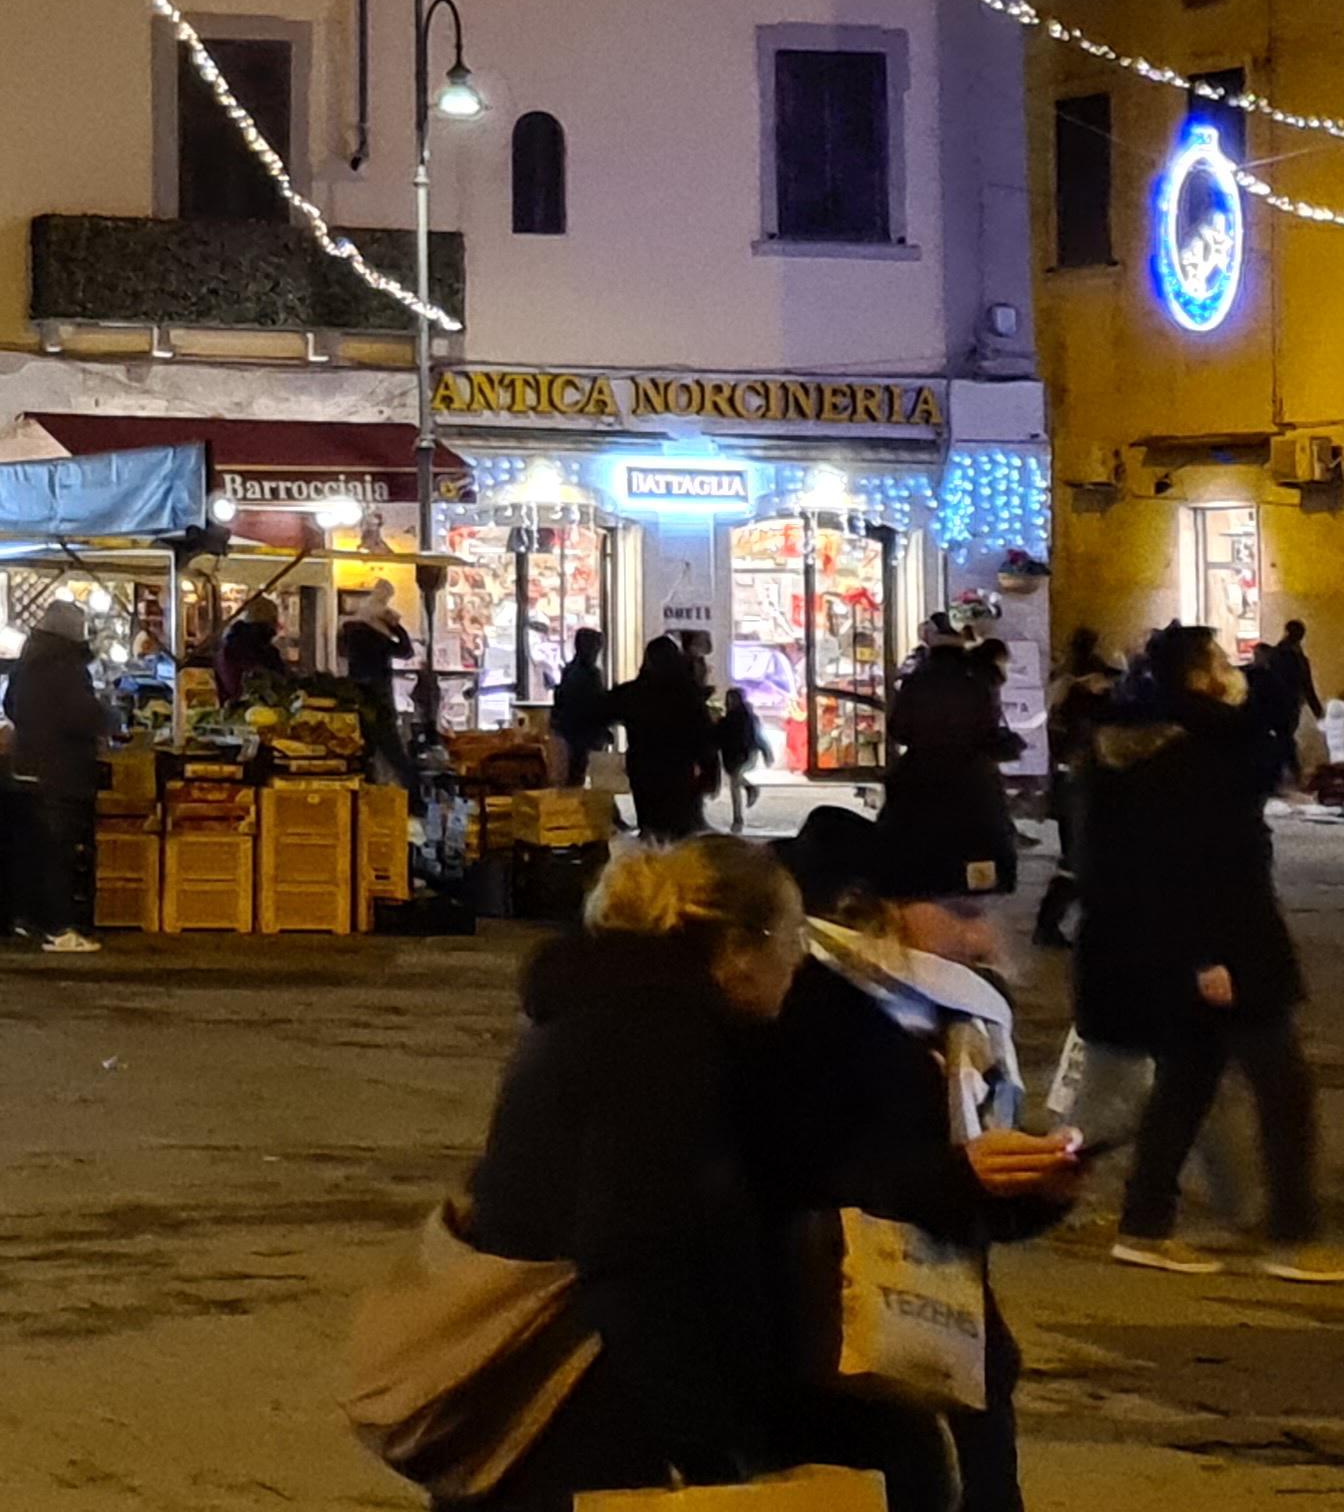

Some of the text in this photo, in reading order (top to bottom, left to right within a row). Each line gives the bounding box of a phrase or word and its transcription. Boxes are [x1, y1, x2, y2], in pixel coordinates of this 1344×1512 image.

[431, 370, 944, 425] ANTICA NORCINERIA
[223, 474, 389, 502] Barrocciaia
[631, 471, 746, 496] BATTAGLIA
